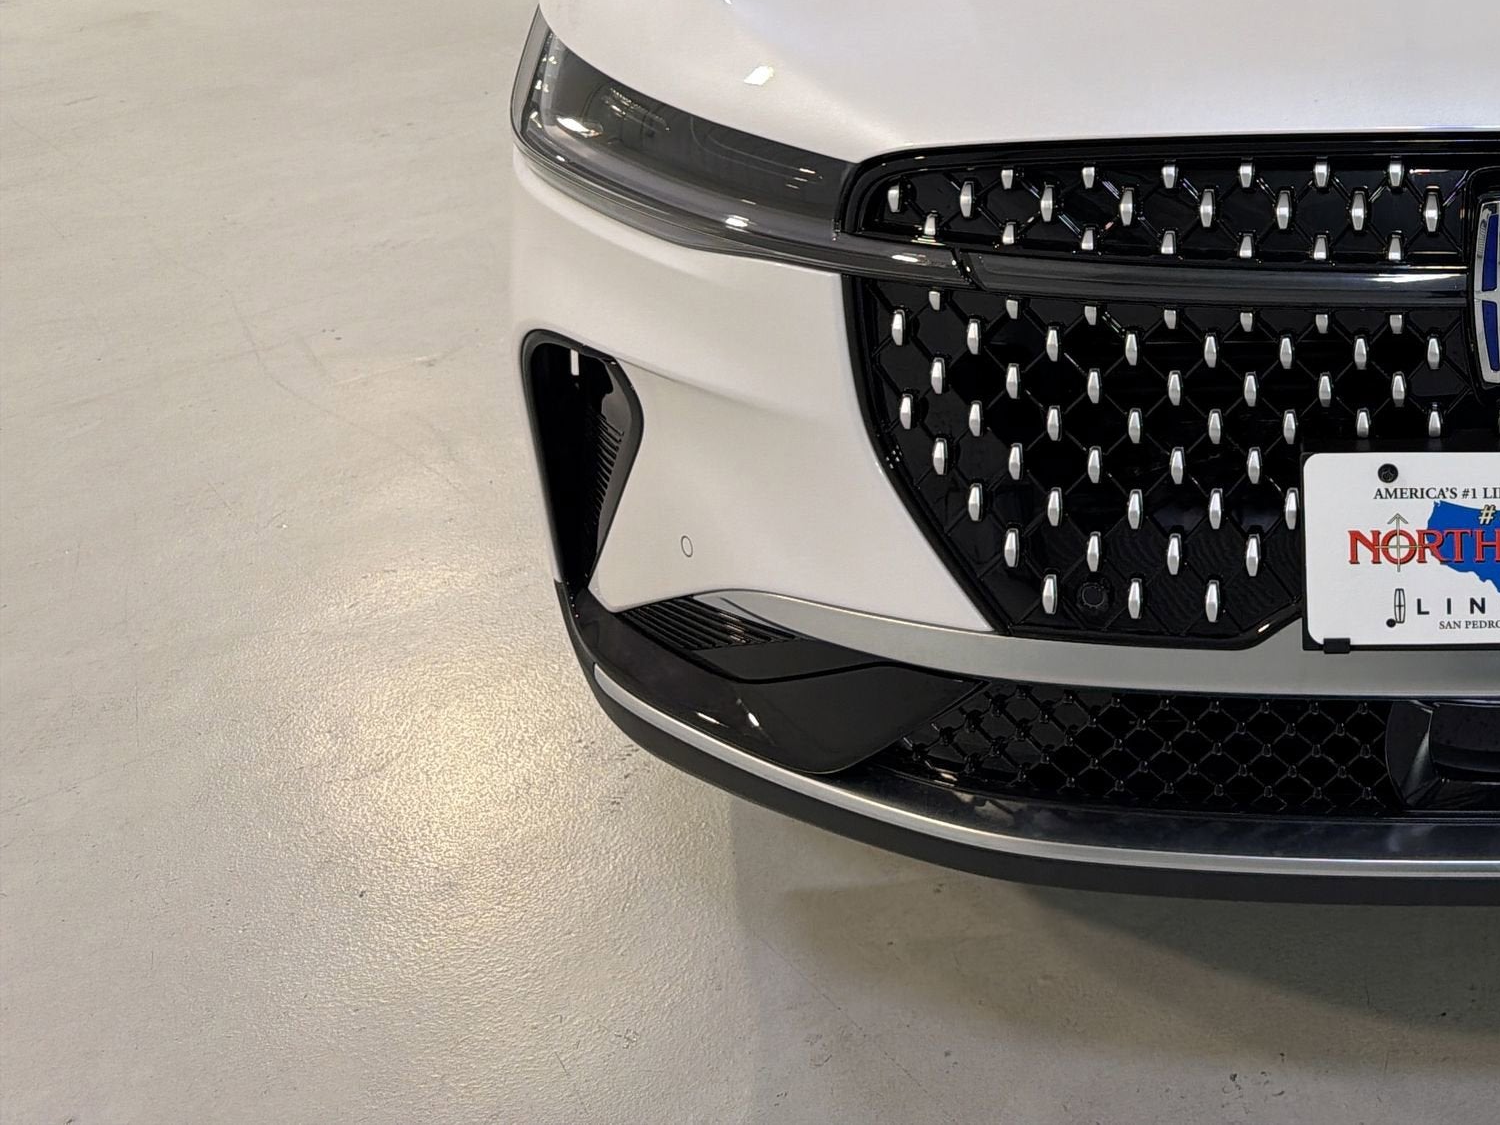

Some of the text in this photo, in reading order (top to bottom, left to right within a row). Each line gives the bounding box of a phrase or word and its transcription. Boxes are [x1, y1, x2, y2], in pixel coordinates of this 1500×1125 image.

[1373, 486, 1458, 500] AMERICA'S
[1461, 487, 1478, 500] #1
[1438, 619, 1461, 630] SAN
